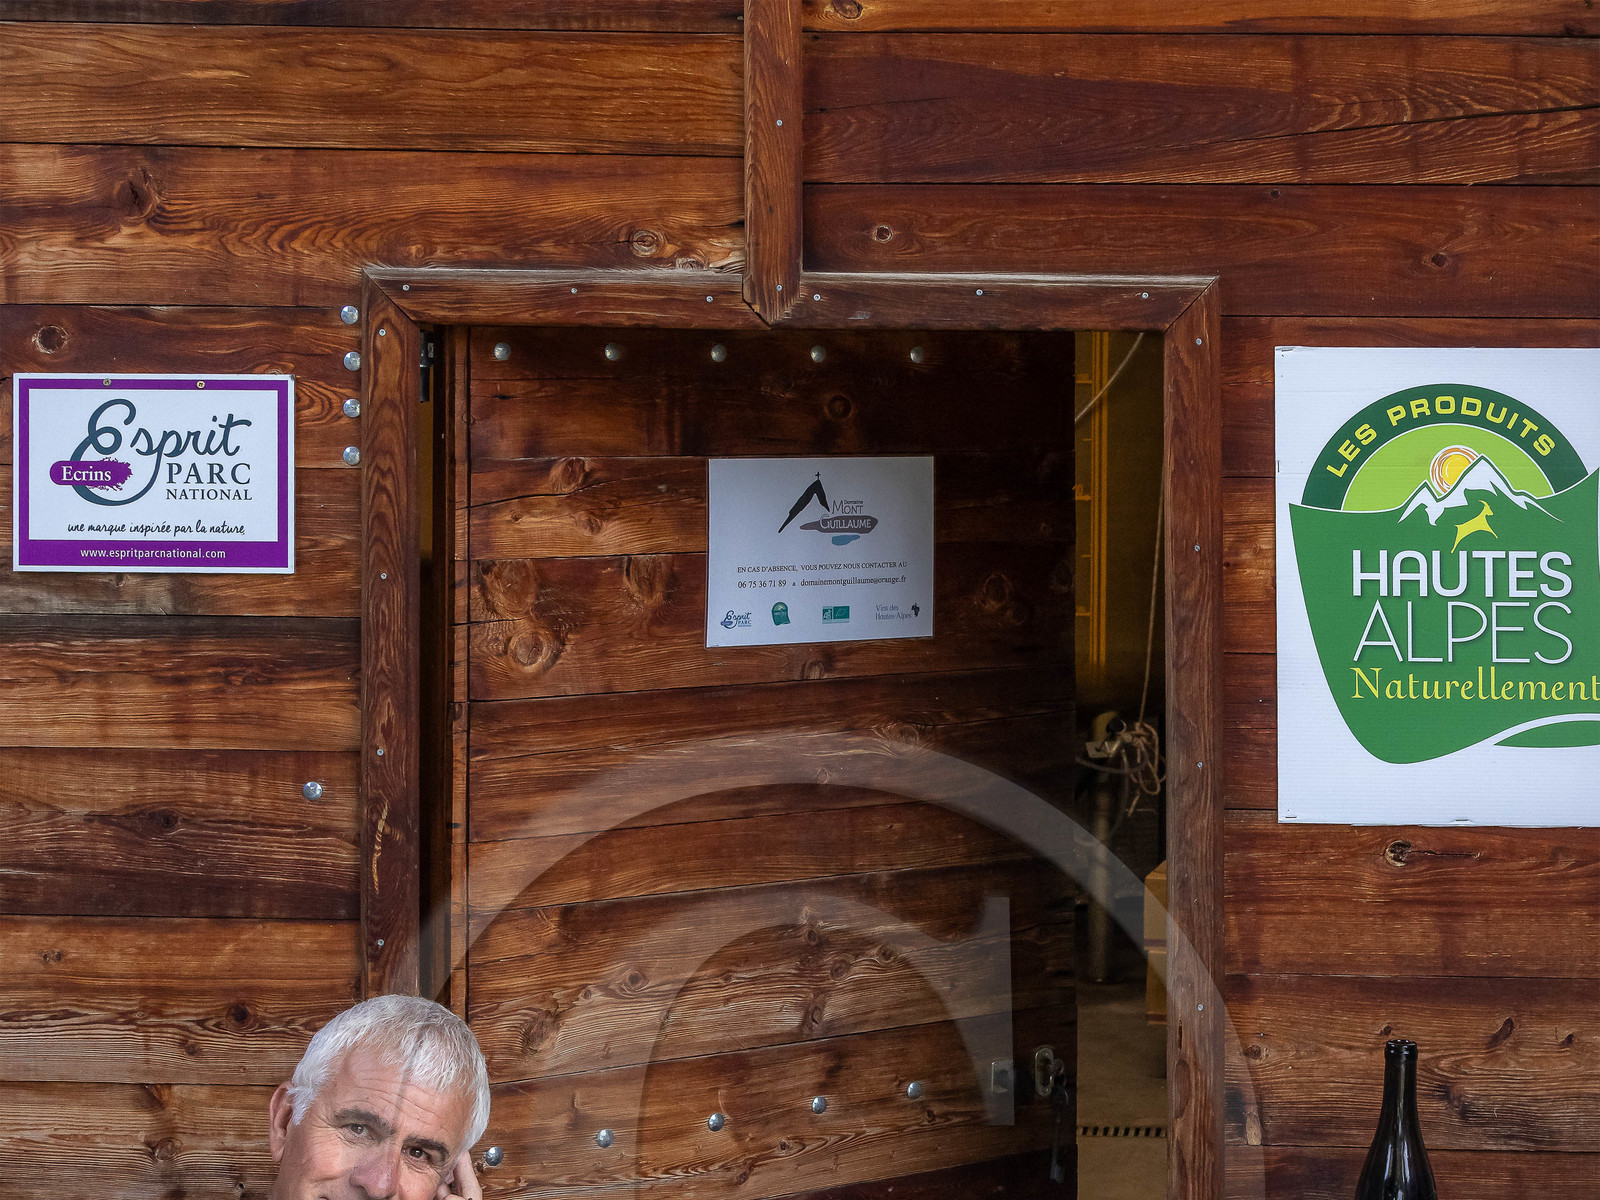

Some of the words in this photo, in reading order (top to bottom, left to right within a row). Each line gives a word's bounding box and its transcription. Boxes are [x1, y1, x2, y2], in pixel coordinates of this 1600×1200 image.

[1326, 423, 1378, 478] LES
[1387, 395, 1557, 457] PRODUITS
[69, 398, 252, 506] Esprit
[61, 465, 112, 482] Ecrins
[166, 462, 251, 485] PARC
[165, 488, 253, 501] NATIONAL
[67, 523, 85, 533] une
[88, 523, 126, 535] marque
[130, 520, 171, 536] inspirée
[174, 524, 193, 536] par
[195, 520, 207, 534] la
[819, 514, 872, 529] GUILLAUME
[79, 547, 226, 560] www.espritparcnational.com
[861, 561, 897, 569] CONTACTER
[1352, 549, 1573, 598] HAUTES
[758, 580, 767, 588] 36
[778, 579, 787, 587] 89
[1352, 600, 1574, 664] ALPES
[1350, 666, 1600, 701] Naturellement
